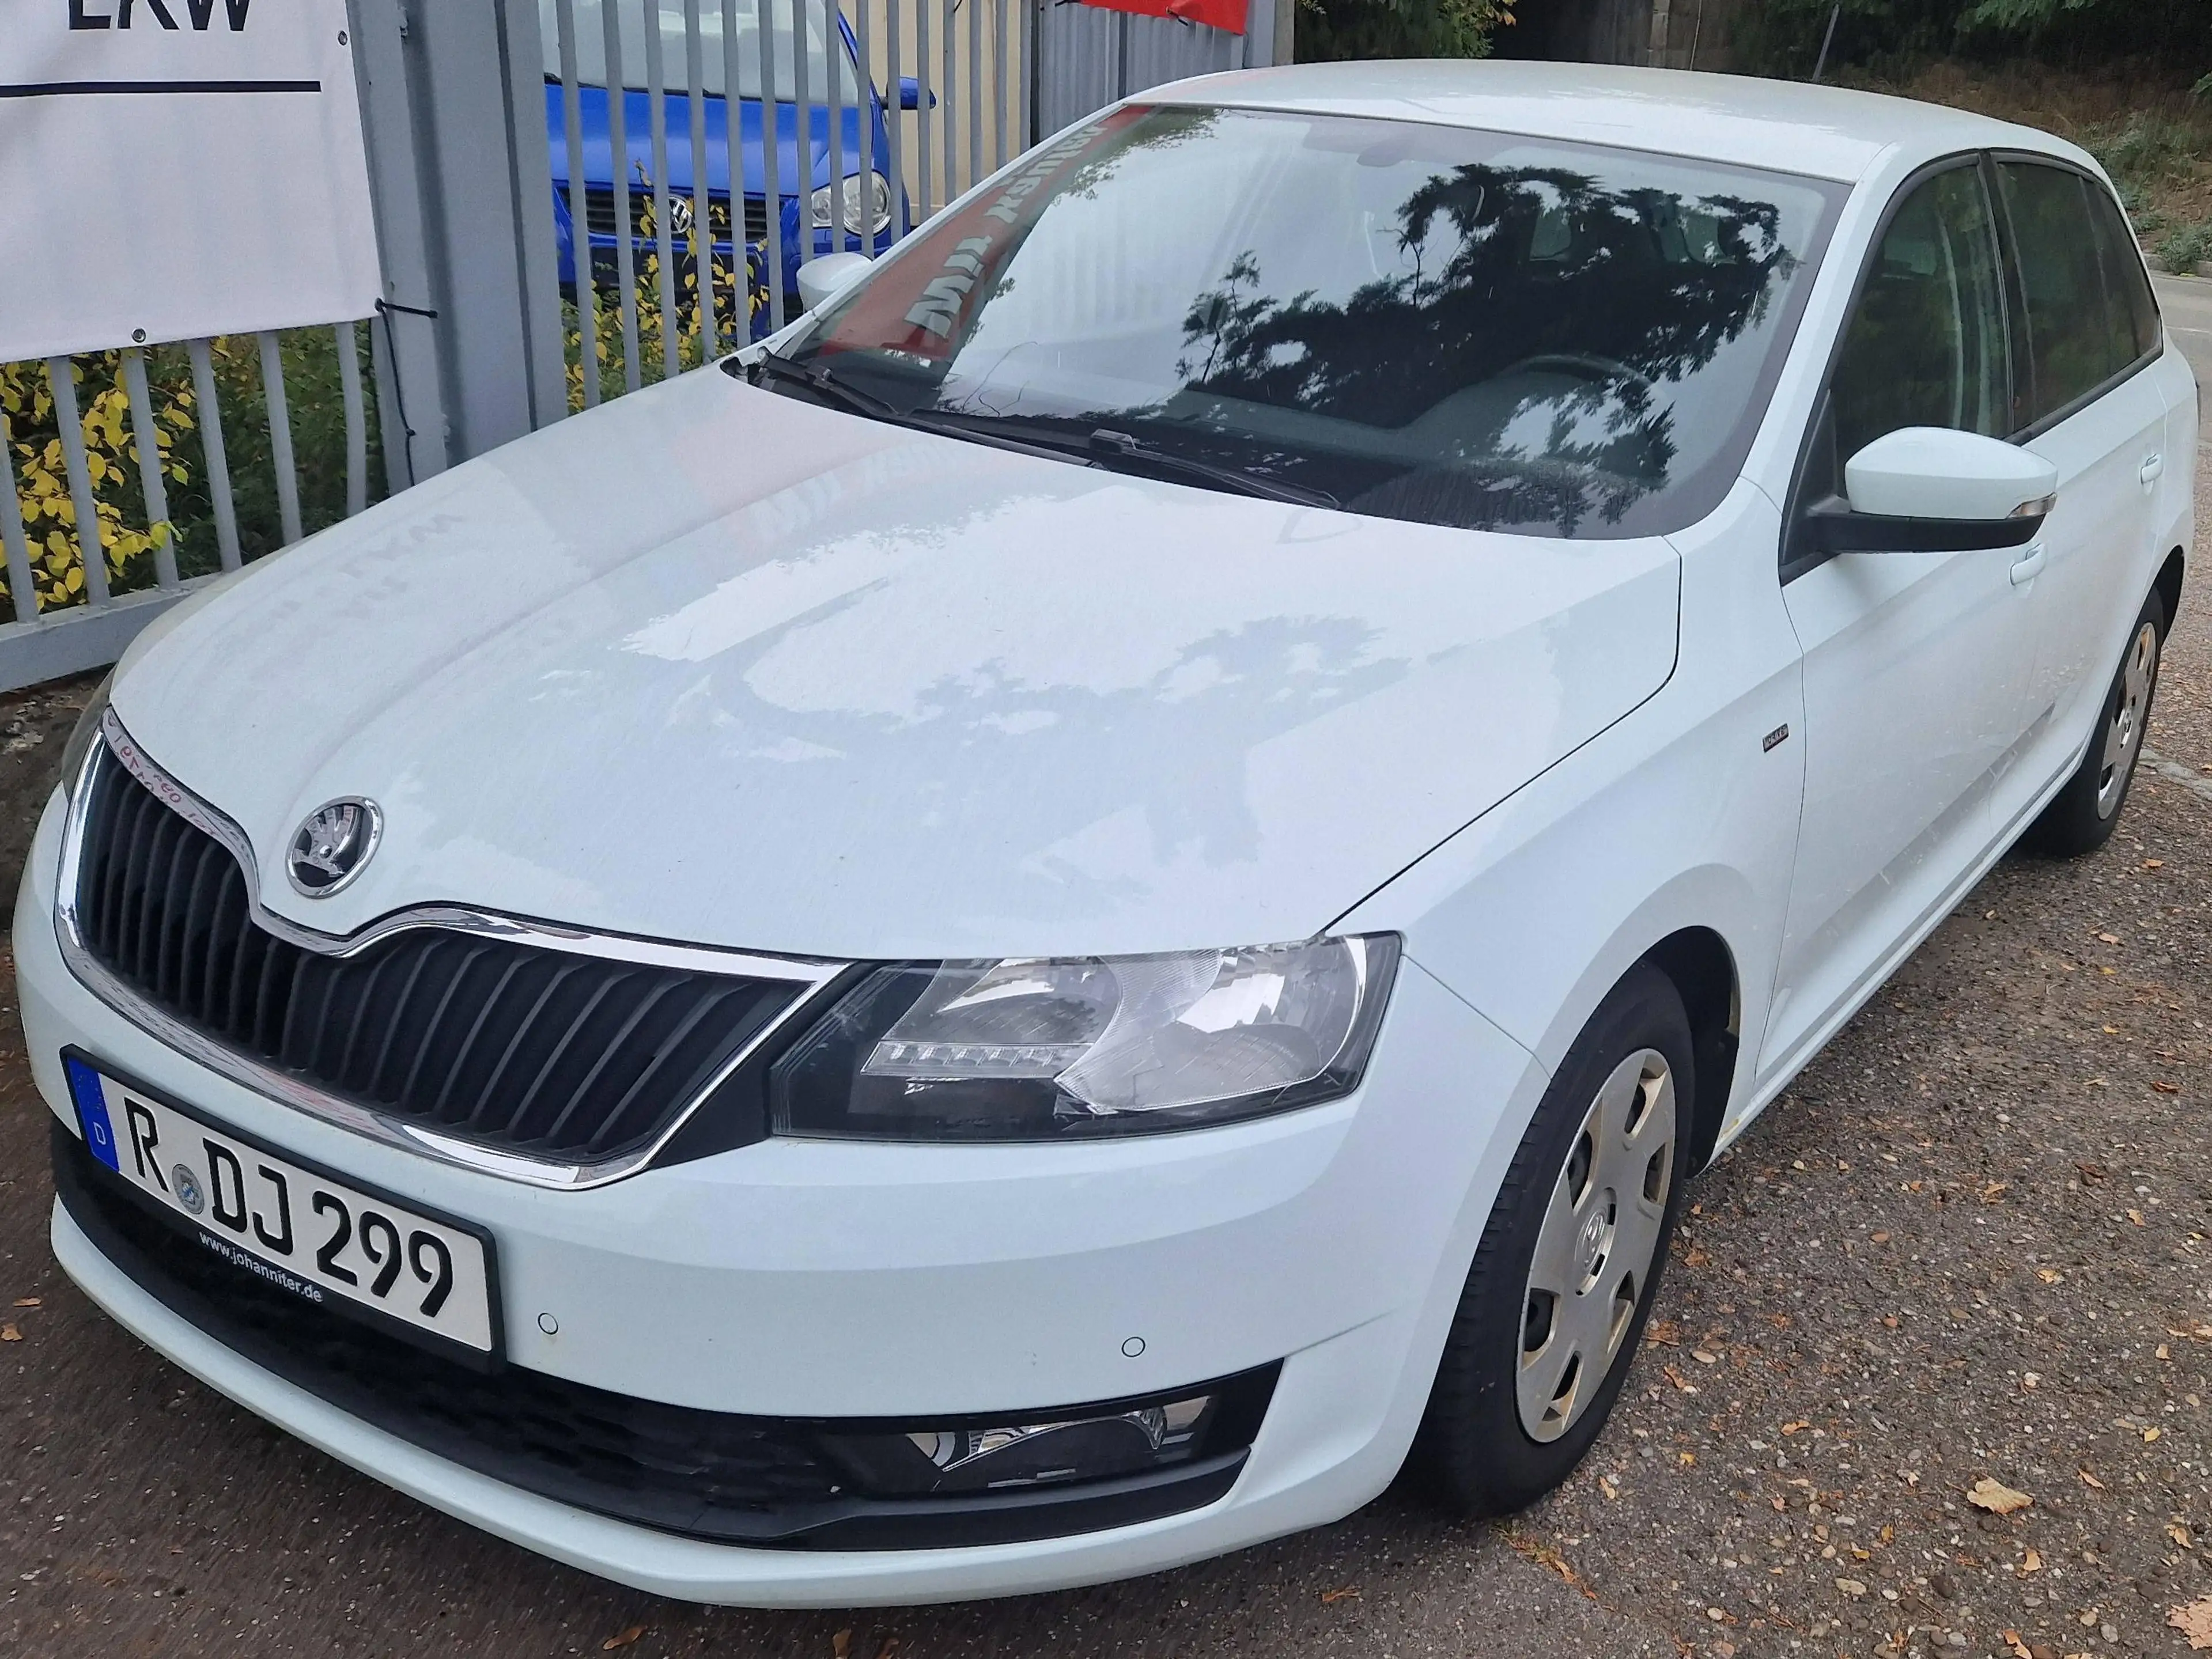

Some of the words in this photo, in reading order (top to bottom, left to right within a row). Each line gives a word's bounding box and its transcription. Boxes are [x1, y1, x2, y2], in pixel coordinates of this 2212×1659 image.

[93, 1121, 106, 1145] D
[124, 1097, 169, 1192] R
[203, 1138, 293, 1256] DJ
[312, 1191, 453, 1317] 299
[199, 1231, 324, 1302] www.johanniter.de
